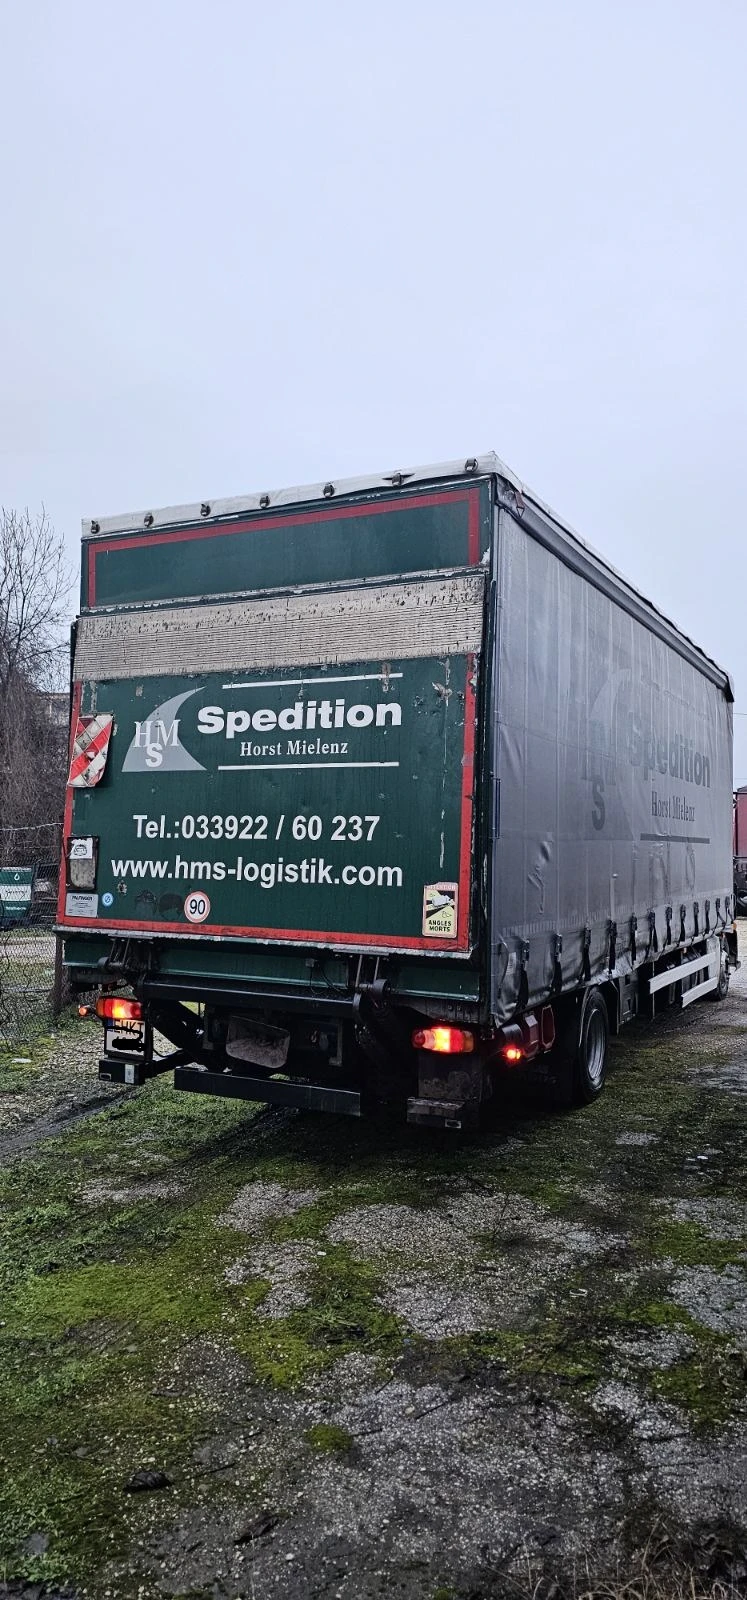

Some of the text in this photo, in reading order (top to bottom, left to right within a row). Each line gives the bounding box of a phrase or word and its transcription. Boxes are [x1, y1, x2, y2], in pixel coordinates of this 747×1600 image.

[197, 699, 402, 739] Spedition
[240, 738, 349, 756] Horst Mielenz
[627, 711, 711, 788] Spedition
[651, 790, 696, 822] Horst Mielenz
[132, 814, 380, 841] Tel.:033922 / 60 237
[111, 854, 403, 889] www.hms-logistik.com
[189, 898, 206, 915] 90
[428, 919, 452, 927] ANGLES
[429, 925, 451, 933] MORTS
